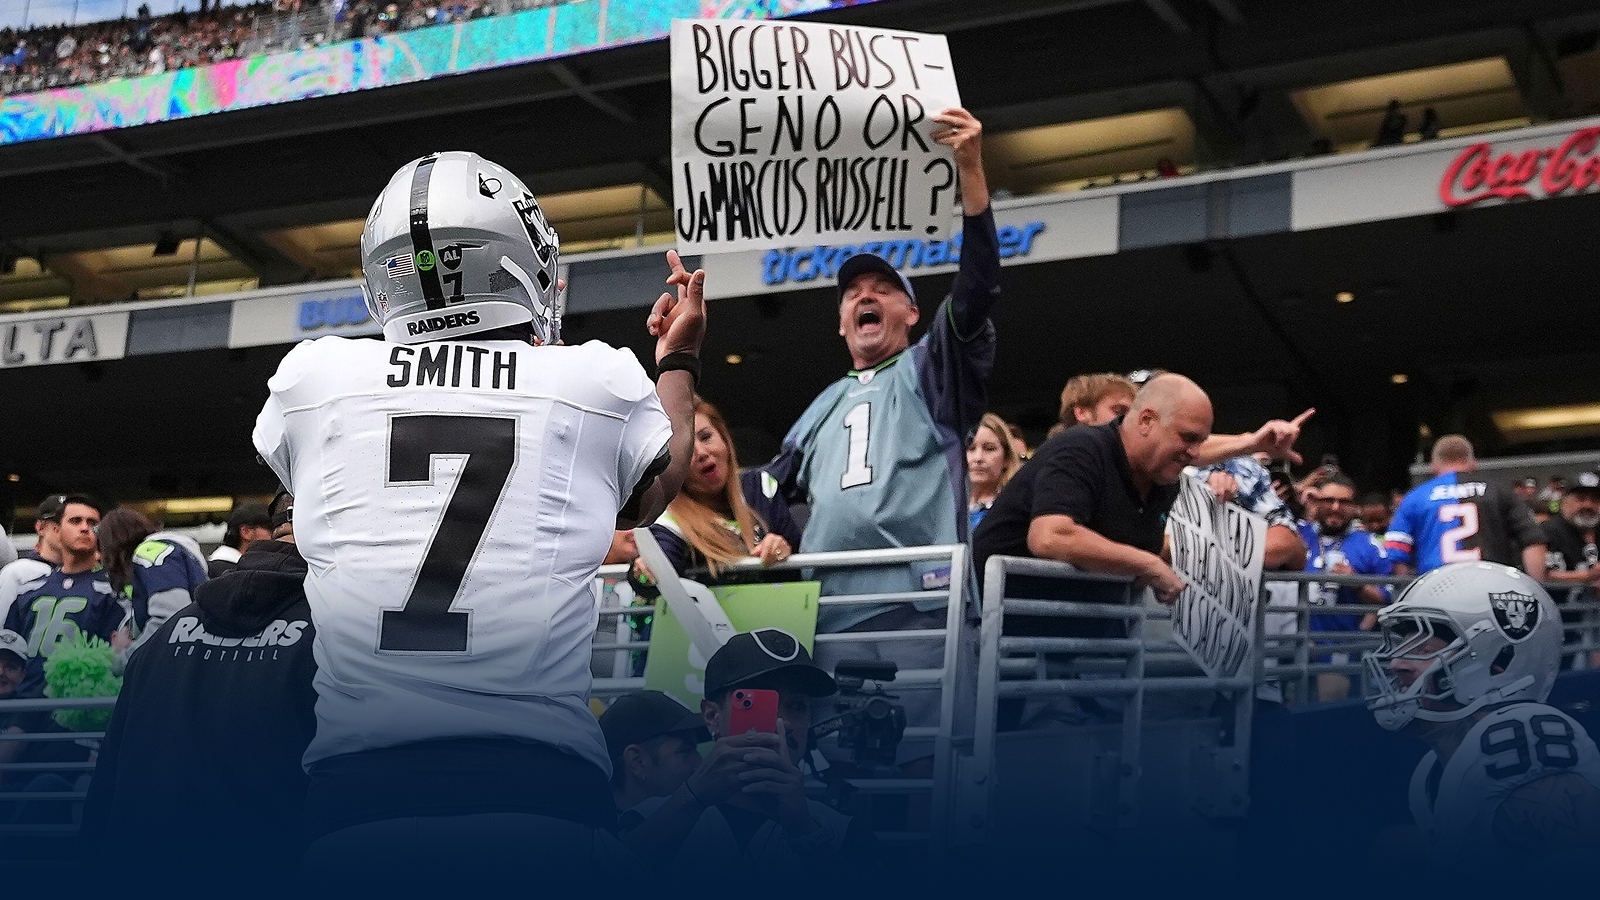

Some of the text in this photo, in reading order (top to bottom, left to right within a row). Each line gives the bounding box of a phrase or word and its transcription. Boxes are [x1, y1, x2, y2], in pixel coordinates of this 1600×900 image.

[692, 24, 817, 94] BIGGER
[695, 94, 930, 157] GENO OR
[443, 249, 461, 262] AL
[442, 270, 466, 303] 7
[406, 310, 481, 336] RAIDERS
[386, 345, 517, 390] SMITH
[840, 401, 873, 491] 1
[374, 412, 522, 657] 7
[1438, 502, 1482, 563] 2
[27, 596, 88, 658] 16
[168, 616, 309, 647] RARS
[1480, 714, 1579, 780] 98
